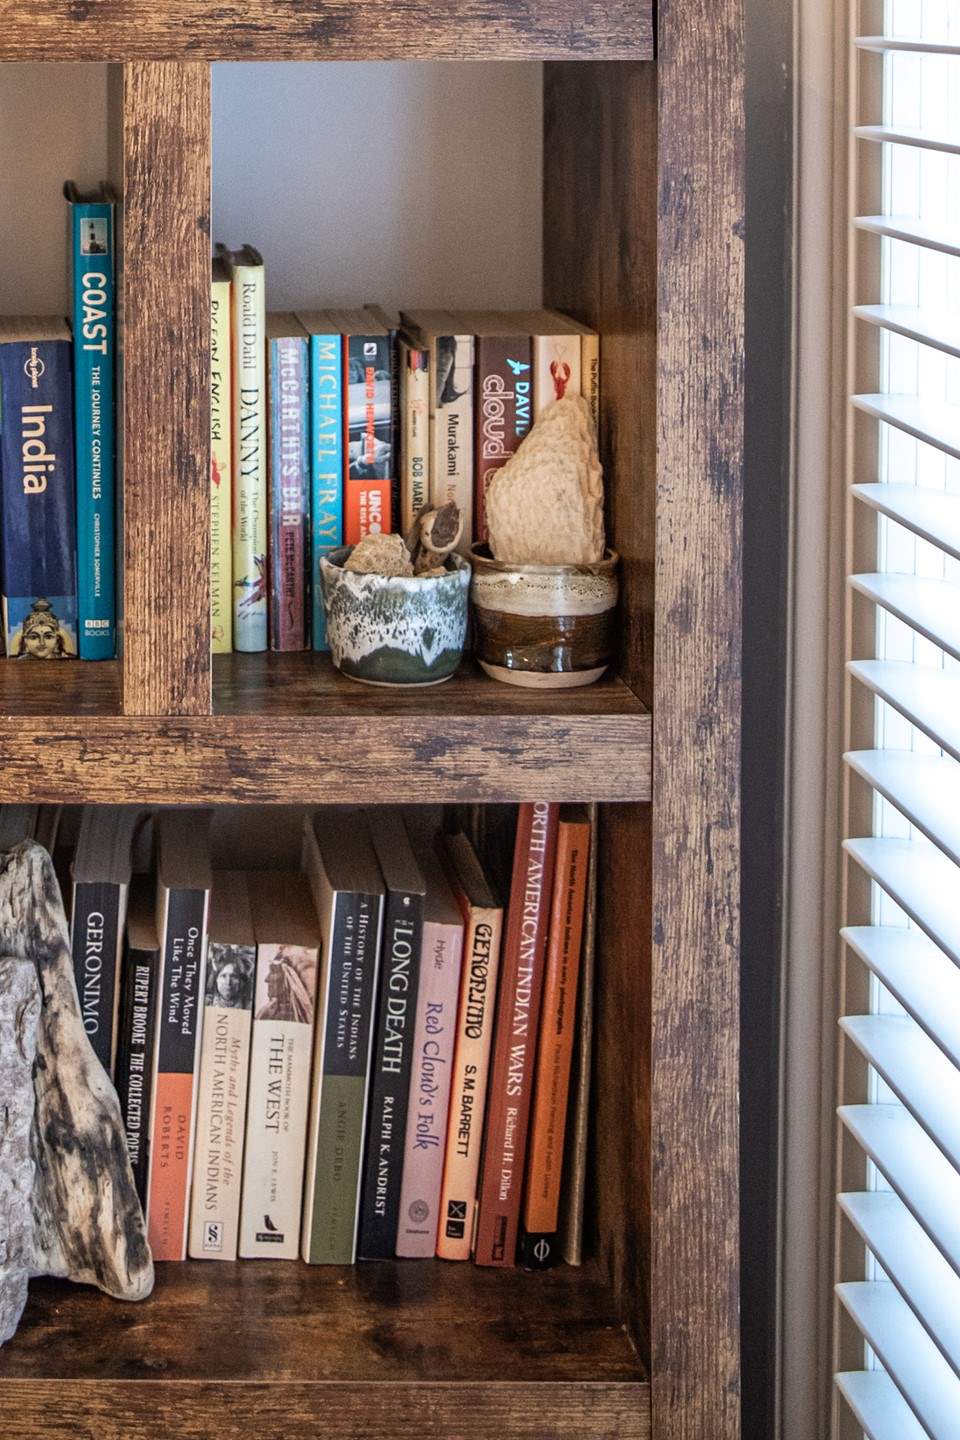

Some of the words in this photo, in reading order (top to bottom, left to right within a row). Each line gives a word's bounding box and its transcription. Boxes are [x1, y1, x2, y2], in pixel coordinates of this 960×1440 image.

[82, 272, 108, 355] COAST
[242, 282, 257, 327] Roald
[242, 333, 257, 369] Dahl
[92, 366, 101, 385] THE
[91, 388, 102, 436] JOURNEY
[482, 375, 514, 459] cloud
[21, 404, 57, 495] India
[240, 388, 260, 482] DANNY
[447, 414, 460, 476] Murakami
[91, 439, 102, 499] CONTINUES
[93, 513, 101, 557] CHRISTOPHER
[93, 558, 102, 597] SOMERVILLE
[528, 801, 548, 852] ORTH
[520, 858, 543, 960] AMERICAN
[172, 938, 184, 962] Like
[187, 927, 199, 957] Once
[389, 927, 414, 991] LONG
[83, 911, 105, 1035] GERONIMO
[135, 965, 149, 1002] RUPERT
[170, 965, 182, 988] The
[183, 961, 197, 991] They
[465, 923, 492, 1039] GERONIMO
[168, 992, 181, 1023] Wind
[181, 994, 195, 1034] Moved
[425, 1001, 443, 1034] Red
[513, 966, 533, 1036] INDIAN
[131, 1006, 147, 1045] BROOKE
[214, 1014, 228, 1064] NORTH
[381, 997, 407, 1073] DEATH
[130, 1052, 145, 1071] THE
[227, 1037, 240, 1078] Myths
[268, 1034, 285, 1074] THE
[420, 1041, 446, 1105] Cloud's
[506, 1044, 526, 1096] WARS
[127, 1074, 143, 1129] COLLECTED
[209, 1069, 225, 1144] AMERICAN
[228, 1081, 239, 1098] and
[265, 1080, 283, 1135] WEST
[160, 1105, 173, 1168] ROBERTS
[175, 1114, 187, 1160] DAVID
[224, 1101, 238, 1148] Legends
[382, 1096, 395, 1139] RALPH
[413, 1113, 439, 1151] Folk
[457, 1095, 474, 1158] BARRETT
[503, 1107, 518, 1148] Richard
[223, 1152, 235, 1165] of
[381, 1144, 391, 1156] K.
[502, 1152, 514, 1165] H.
[205, 1150, 221, 1210] INDIANS
[222, 1167, 235, 1185] the
[375, 1158, 388, 1217] ANDRIST
[498, 1168, 513, 1201] Dillon
